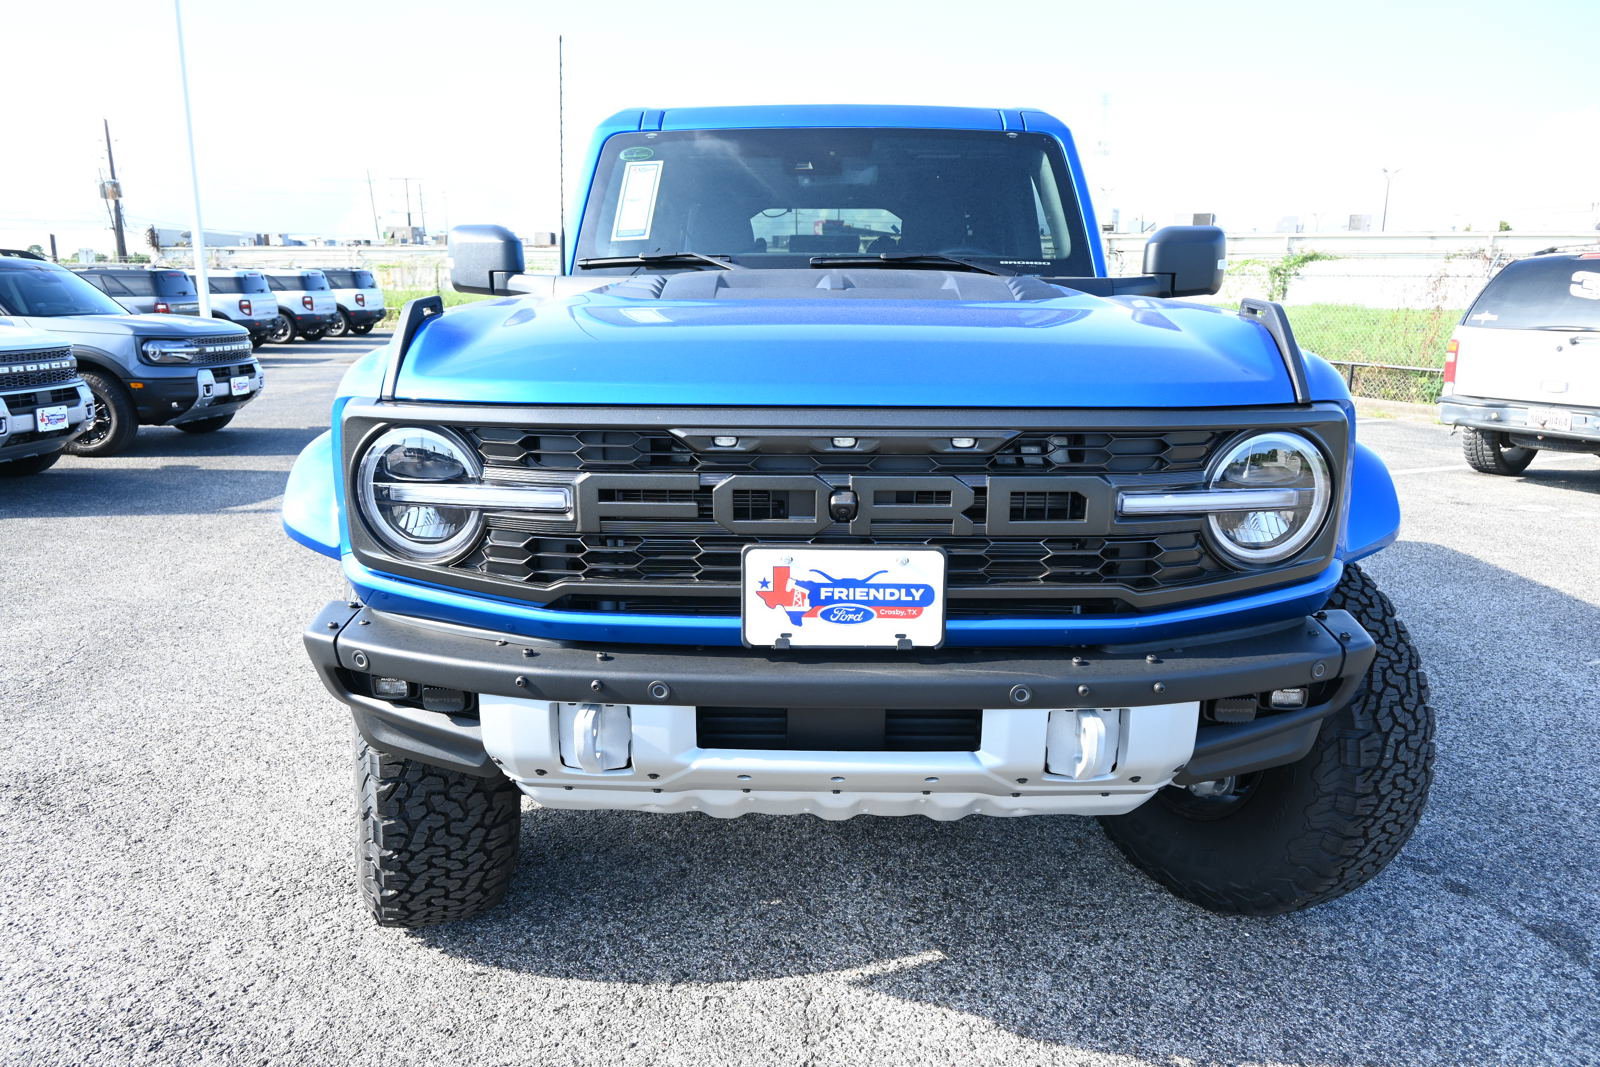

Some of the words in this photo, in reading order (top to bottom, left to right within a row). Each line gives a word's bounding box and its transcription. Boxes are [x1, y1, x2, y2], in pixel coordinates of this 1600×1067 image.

[205, 343, 250, 353] BRONCO
[574, 472, 1118, 536] FORD
[820, 587, 925, 601] FRIENDLY
[830, 607, 864, 622] Ford
[879, 608, 906, 617] Crosby,
